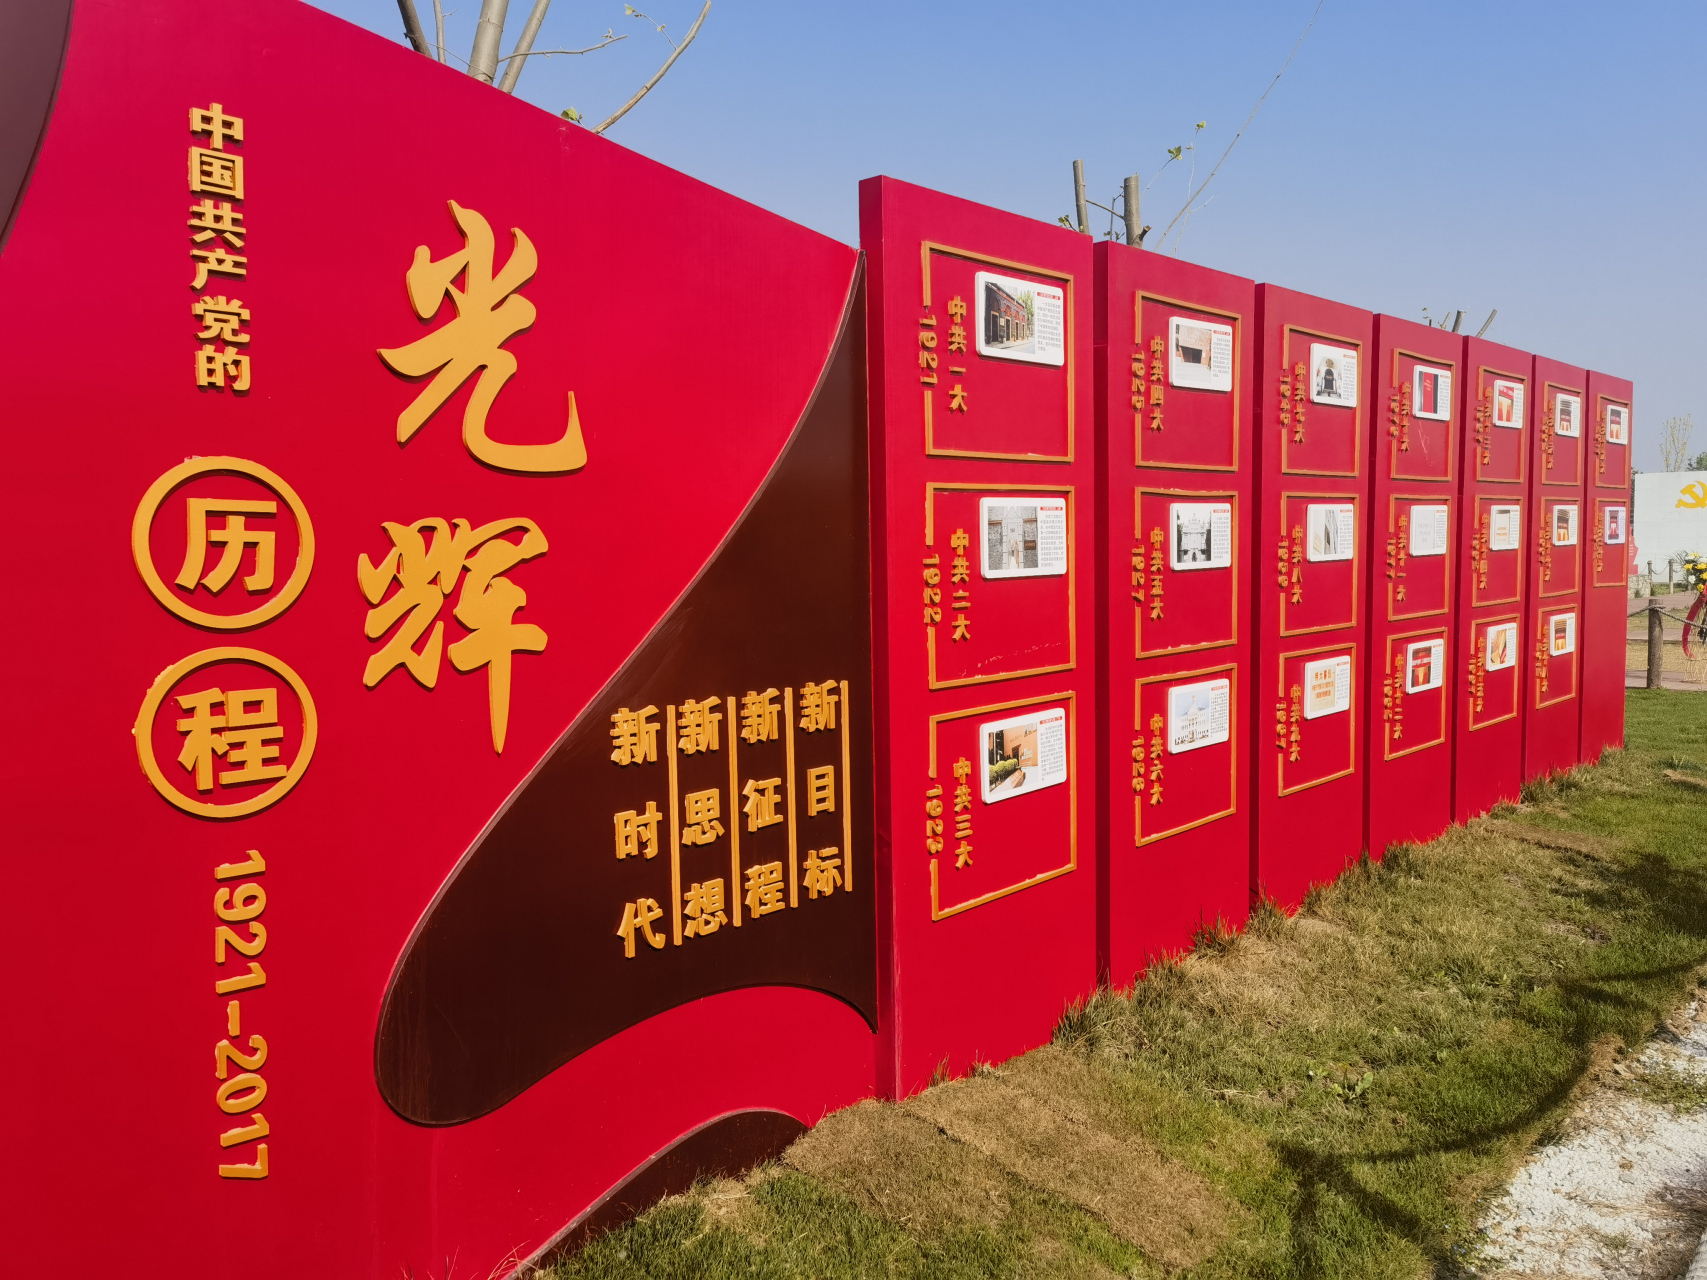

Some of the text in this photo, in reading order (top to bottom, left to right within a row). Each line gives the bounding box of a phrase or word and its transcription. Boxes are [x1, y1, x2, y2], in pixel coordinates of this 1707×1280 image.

[187, 102, 250, 391] 中国共产党的
[920, 314, 938, 386] 1921
[948, 295, 967, 413] 中共一大
[1131, 351, 1145, 411] 1925
[1150, 335, 1164, 432] 中共四大
[358, 199, 588, 754] 光辉
[923, 554, 942, 624] 1922
[951, 529, 971, 642] 中共二大
[1131, 545, 1145, 603] 1927
[1150, 527, 1164, 621] 中共五大
[677, 696, 728, 938] 新思想
[740, 687, 786, 919] 新征程
[799, 679, 842, 900] 新目标
[953, 757, 973, 870] 中共三大
[1150, 714, 1164, 807] 中共六大
[610, 705, 666, 959] 新时代
[926, 784, 944, 854] 1923
[214, 849, 270, 1179] 1921-2017
